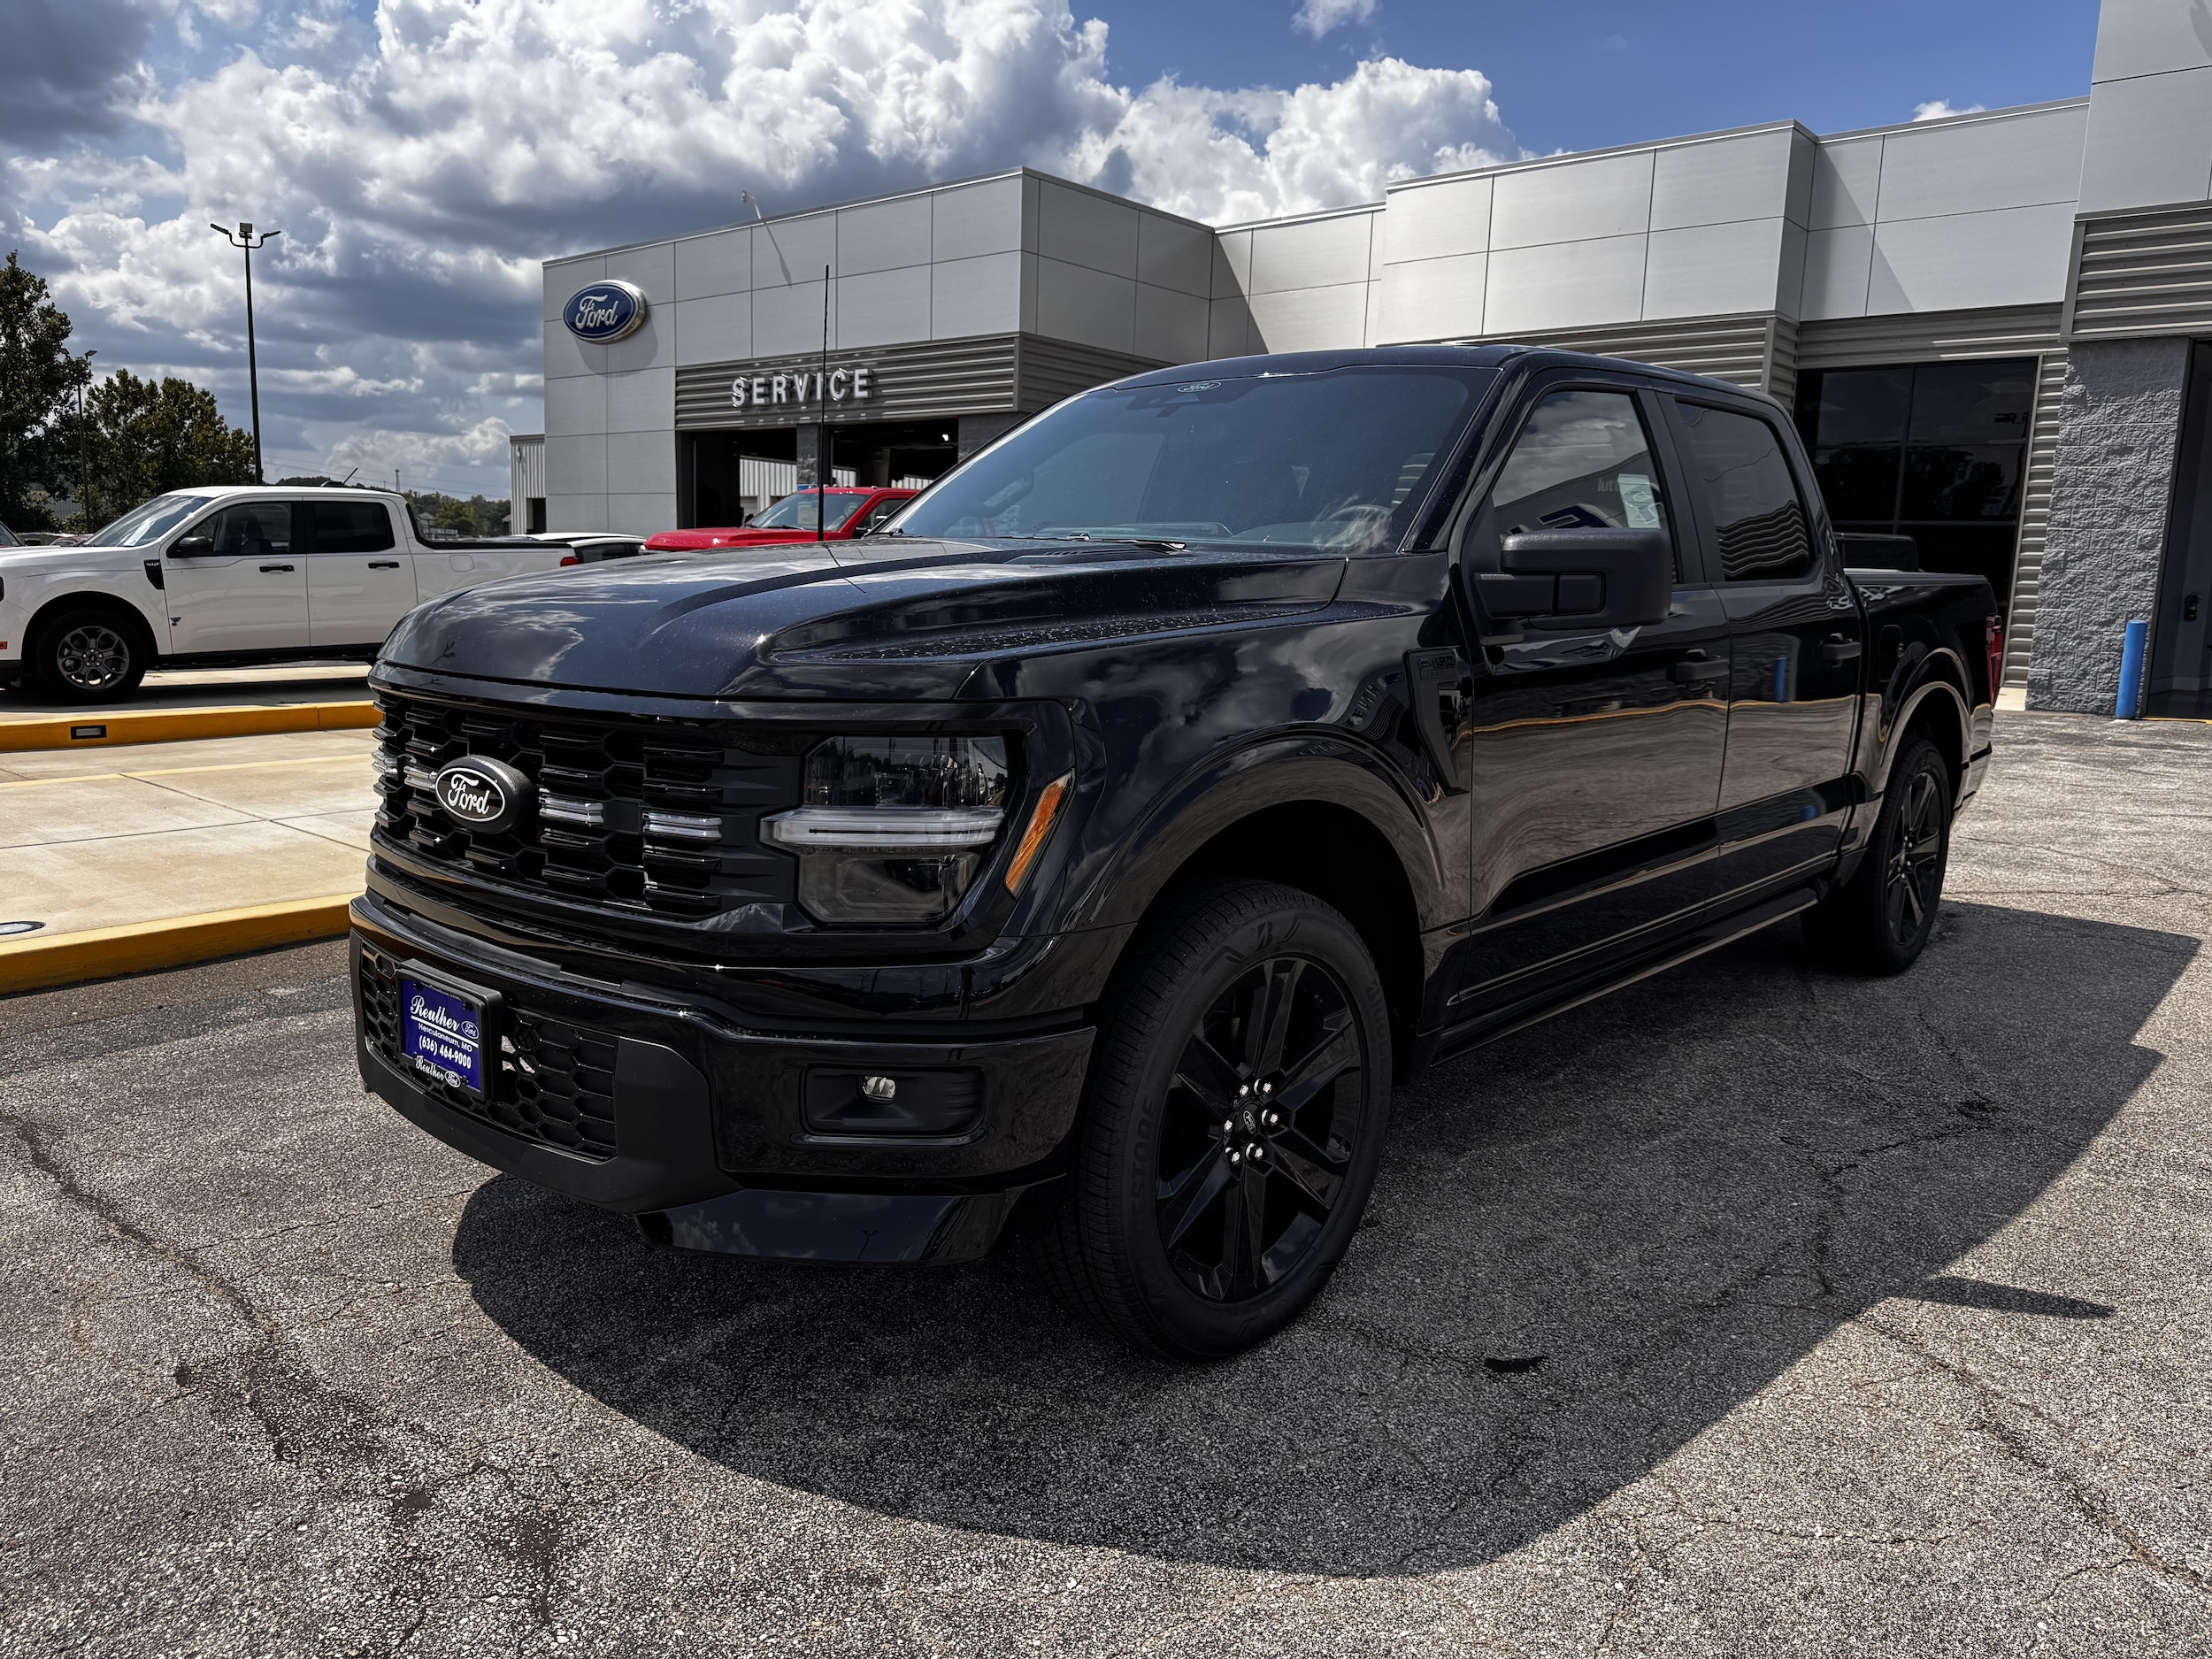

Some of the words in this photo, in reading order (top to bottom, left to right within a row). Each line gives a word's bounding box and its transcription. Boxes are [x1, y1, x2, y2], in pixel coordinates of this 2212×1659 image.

[575, 295, 618, 329] Ford
[732, 368, 869, 407] SERVICE
[447, 773, 491, 815] Ford
[410, 995, 460, 1031] Reuther
[418, 1023, 460, 1048] Herculaneum,
[461, 1041, 472, 1053] MO
[419, 1035, 438, 1056] (636)
[439, 1044, 472, 1069] 464-9000
[415, 1055, 445, 1081] Reuther
